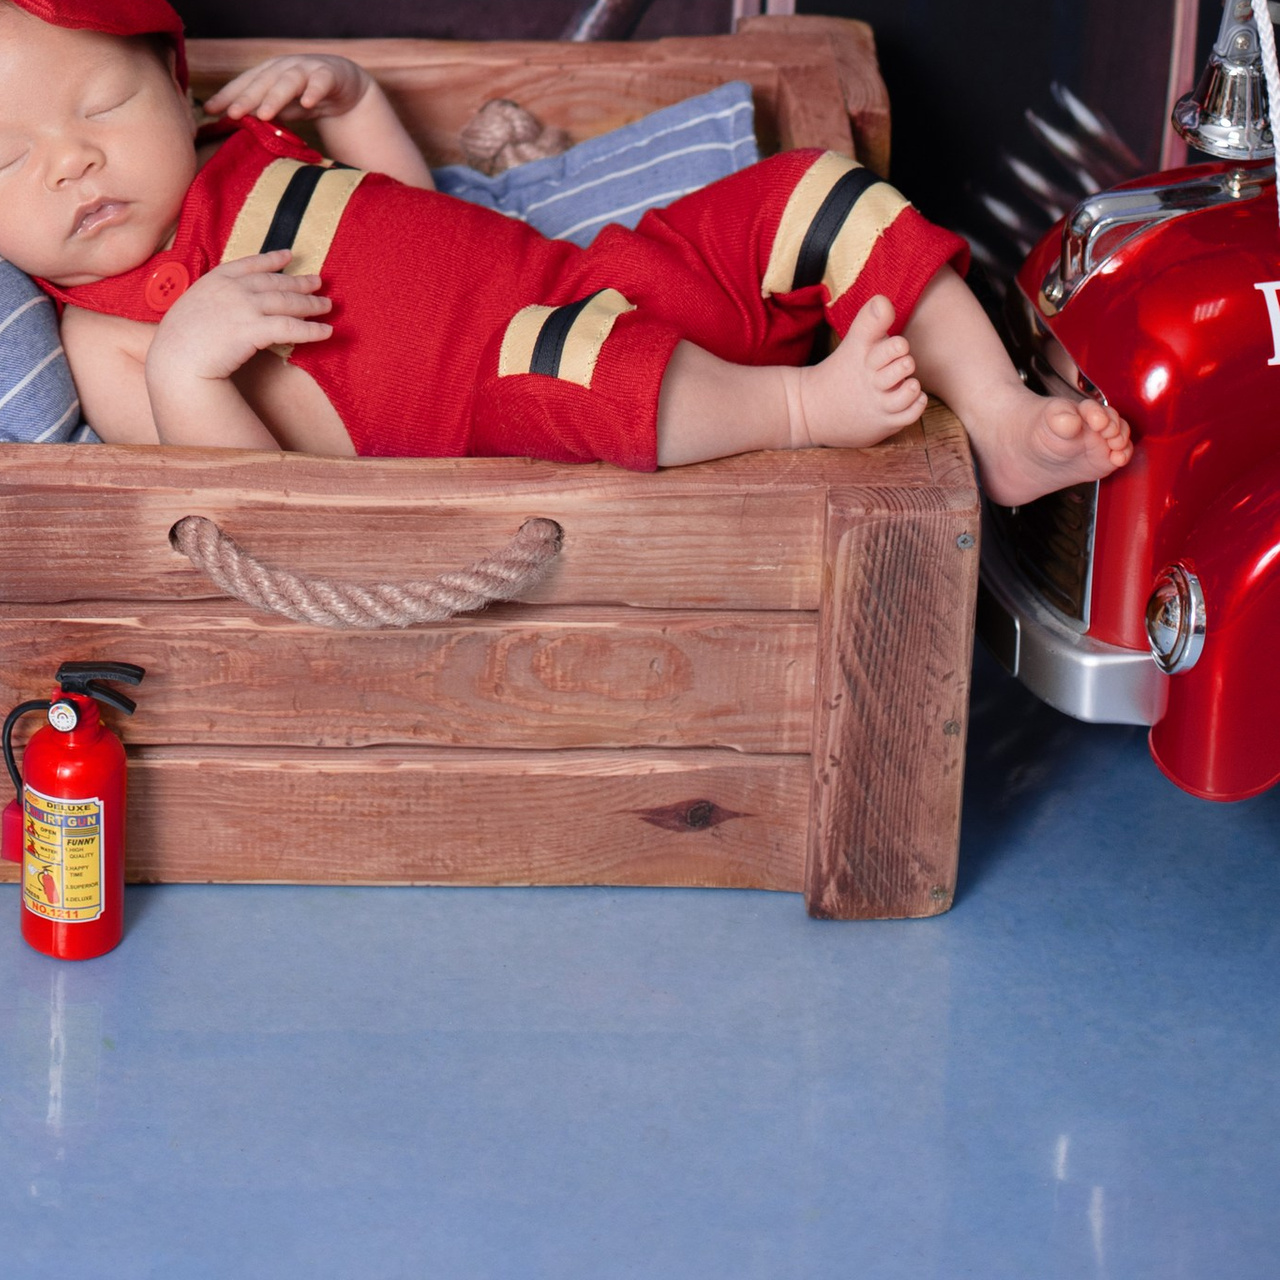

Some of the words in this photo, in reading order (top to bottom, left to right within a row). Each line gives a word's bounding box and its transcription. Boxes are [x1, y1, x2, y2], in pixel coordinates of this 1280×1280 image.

[47, 802, 91, 812] DELUXE
[26, 803, 63, 826] SQUIRT
[67, 815, 96, 827] GUN
[40, 827, 56, 836] OPEN
[67, 837, 96, 846] FUNNY
[40, 846, 58, 854] WATER
